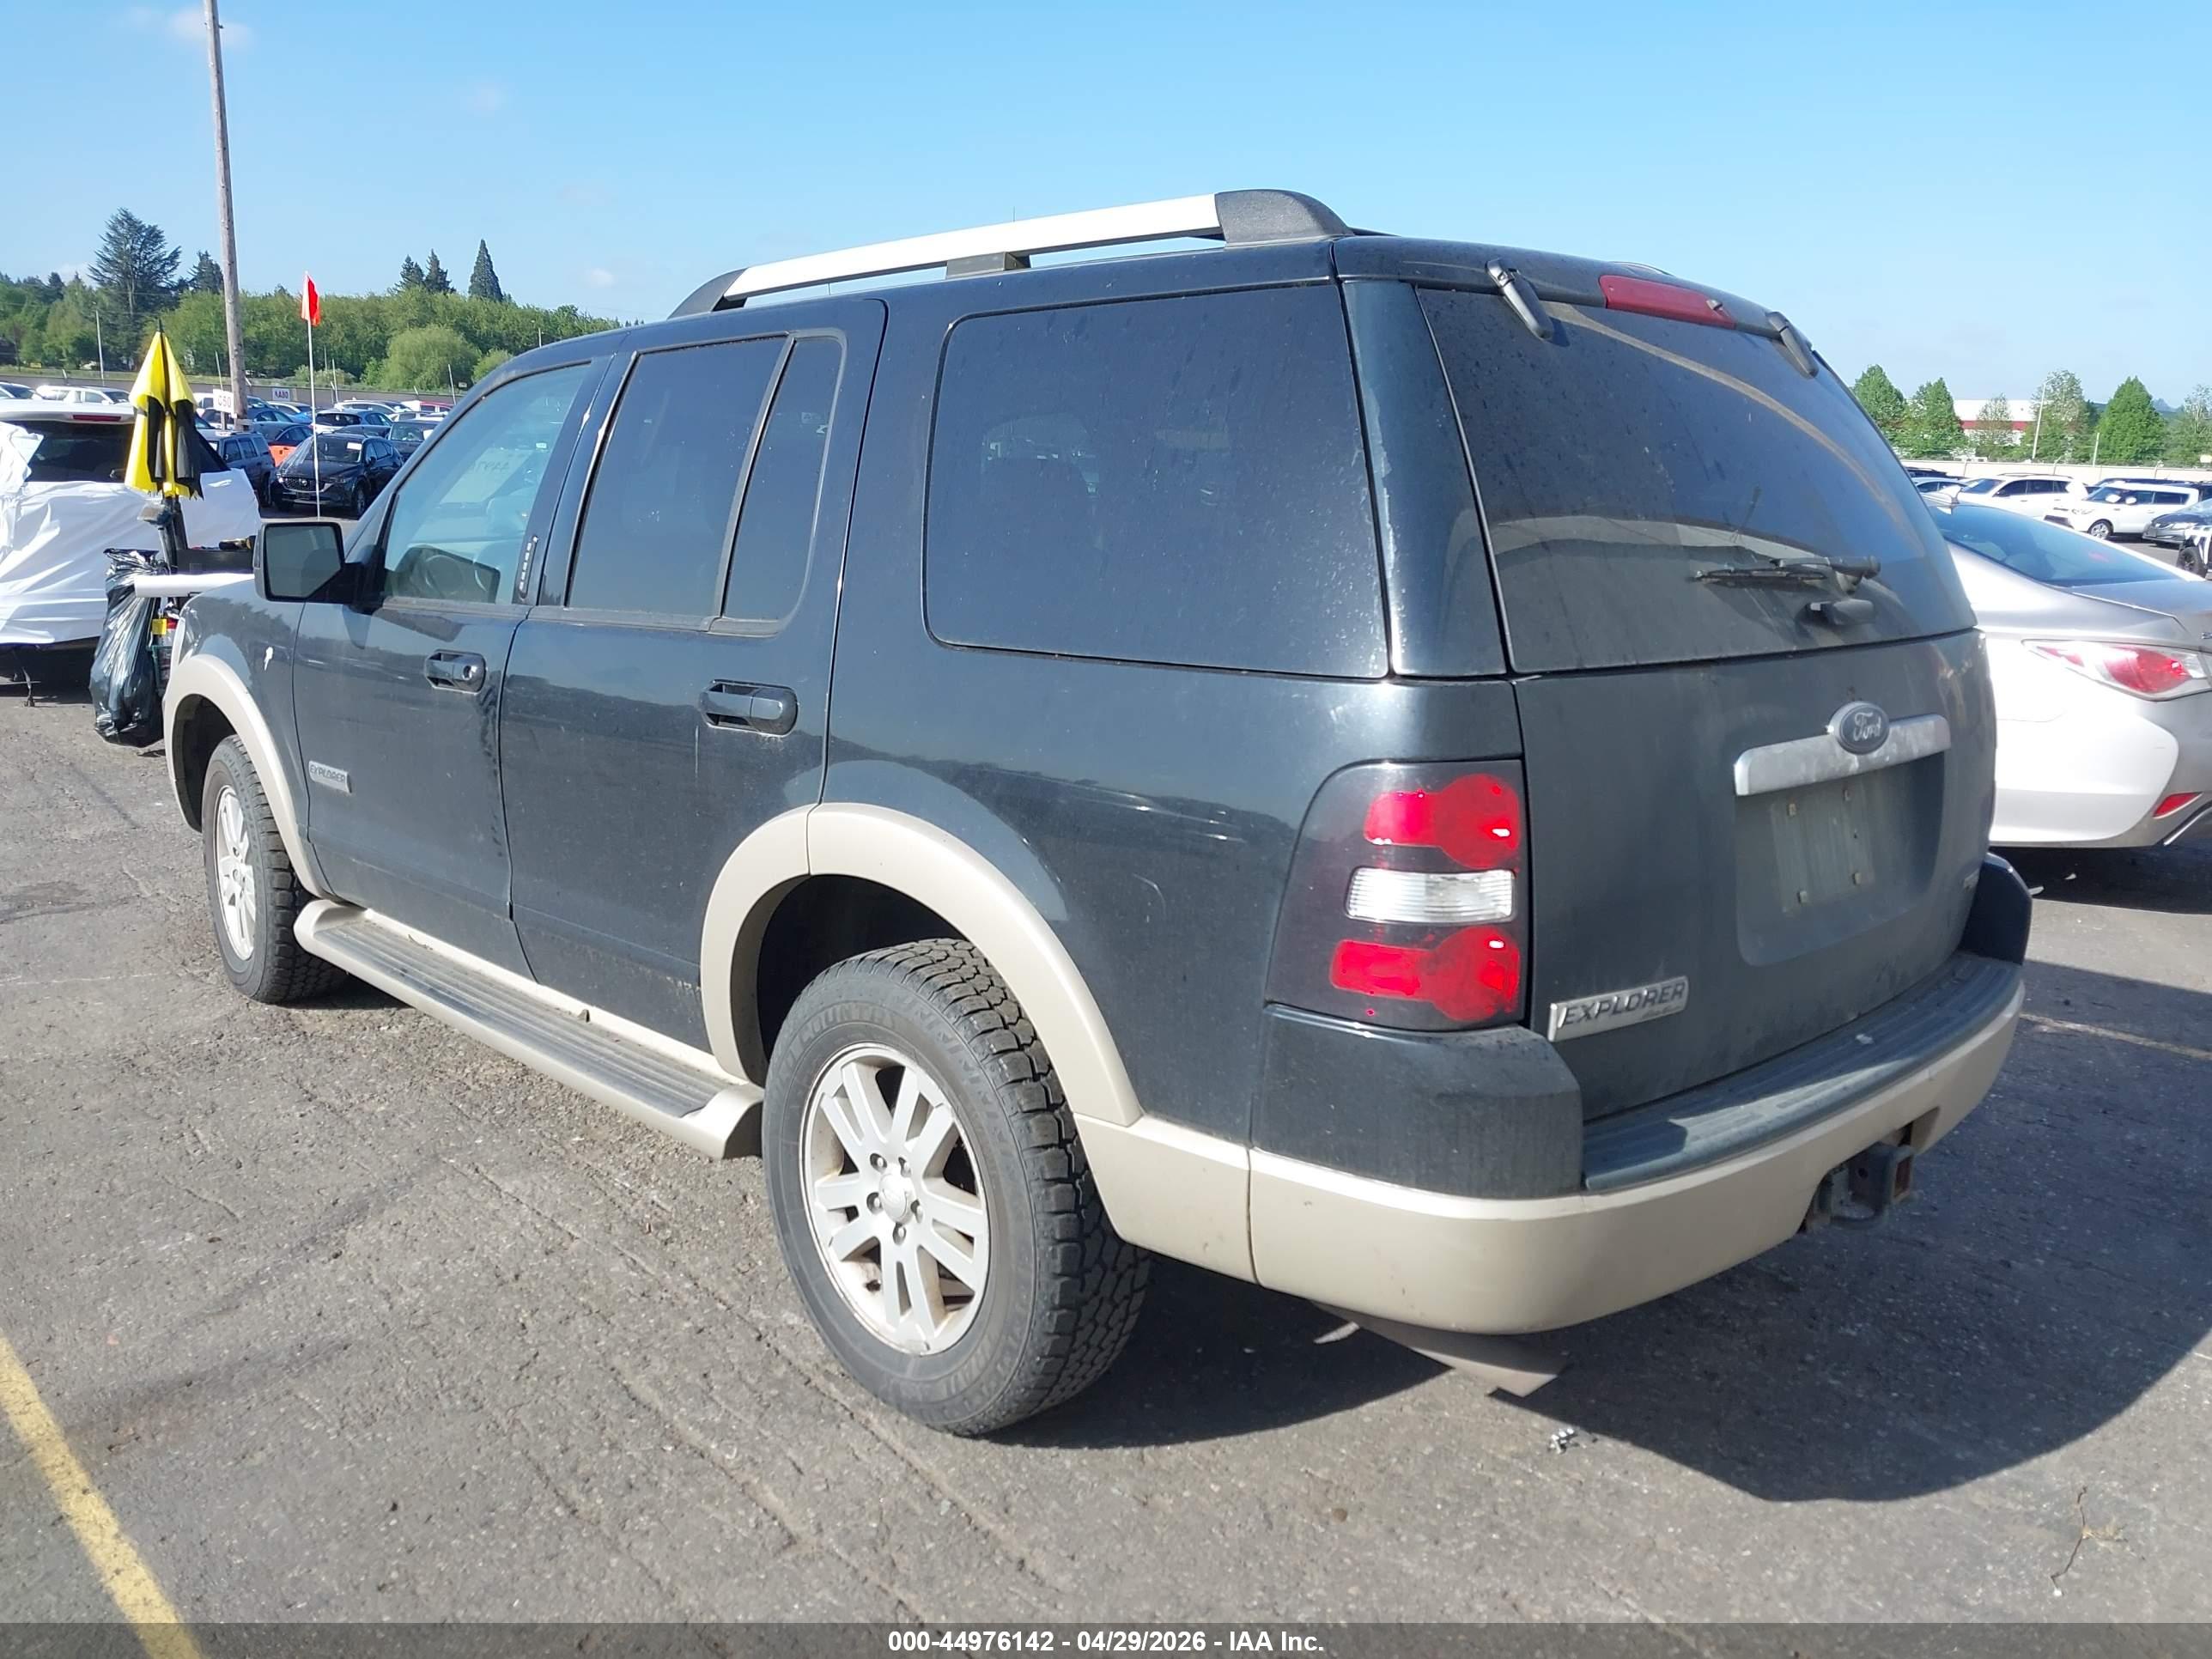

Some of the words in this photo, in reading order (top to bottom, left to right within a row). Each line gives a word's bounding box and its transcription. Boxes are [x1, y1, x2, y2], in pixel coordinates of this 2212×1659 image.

[1853, 711, 1882, 742] Ford
[309, 763, 345, 782] EXPLORER
[1557, 981, 1686, 1029] EXPLORER
